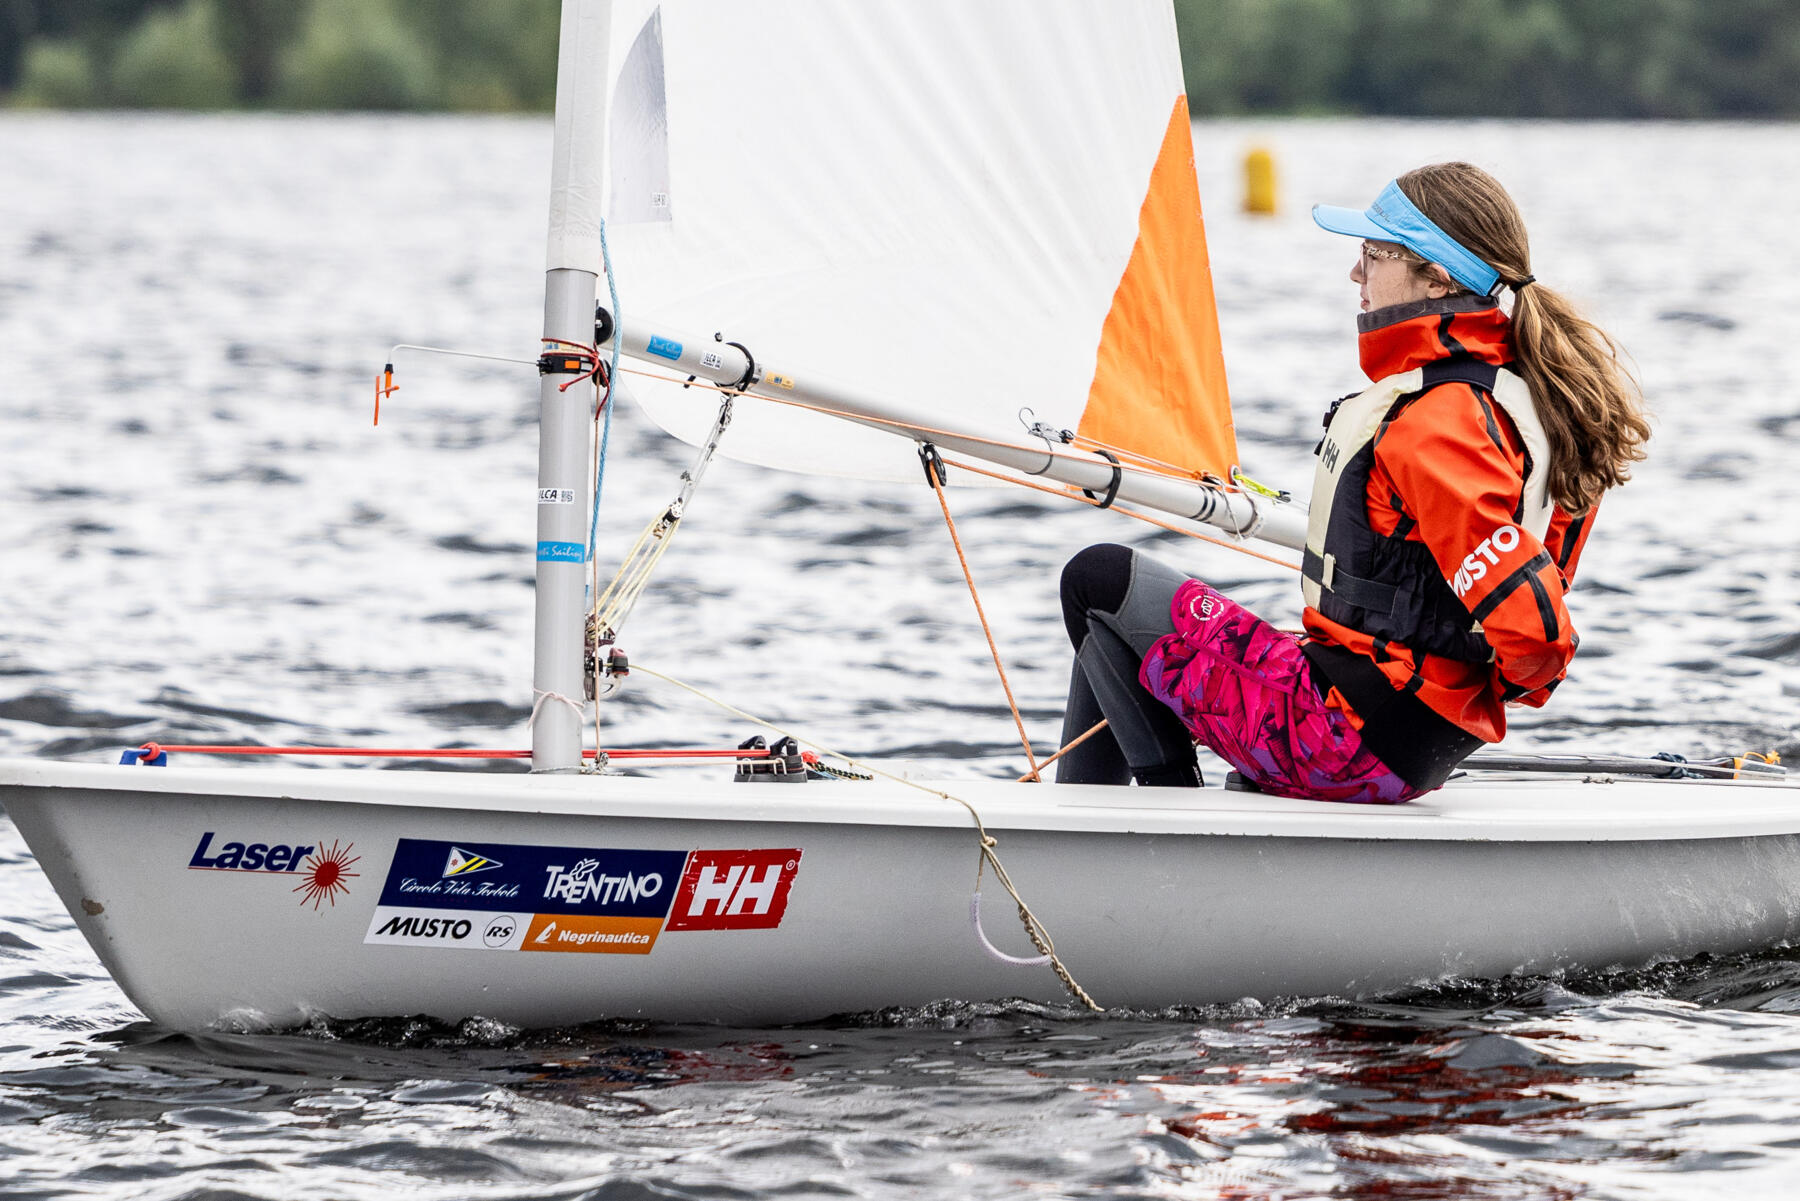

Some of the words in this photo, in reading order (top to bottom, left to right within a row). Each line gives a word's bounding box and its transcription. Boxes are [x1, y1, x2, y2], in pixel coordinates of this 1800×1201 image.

[1322, 438, 1340, 474] HH
[188, 832, 315, 872] Laser
[399, 877, 443, 895] Circolo
[443, 880, 472, 895] Vela
[472, 881, 521, 898] Torbole
[543, 865, 663, 905] TRENTINO
[687, 864, 783, 917] HH
[375, 916, 472, 940] MUSTO
[486, 926, 513, 938] RS
[558, 930, 651, 945] Negrinautica
